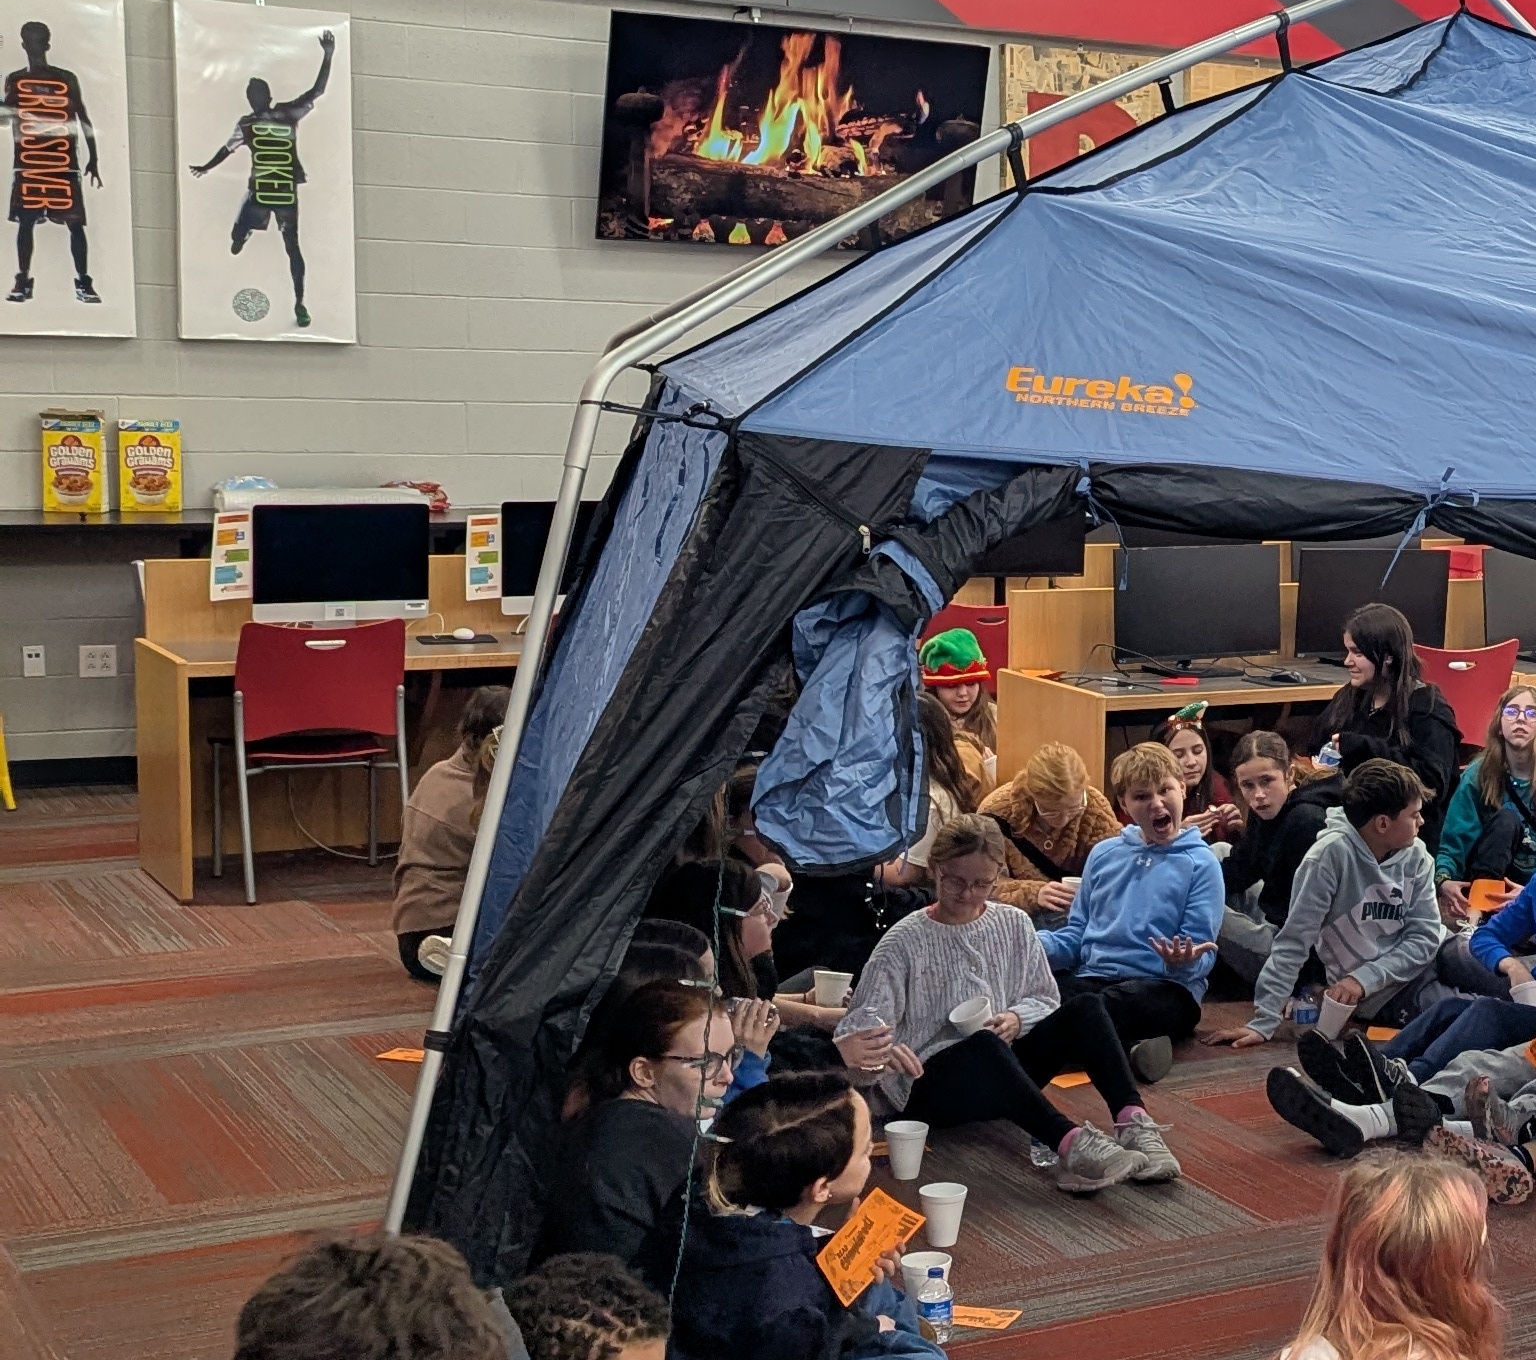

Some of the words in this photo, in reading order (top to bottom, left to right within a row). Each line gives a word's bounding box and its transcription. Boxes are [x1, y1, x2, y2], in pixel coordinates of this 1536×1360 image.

[17, 79, 73, 209] CROSSOVER
[252, 124, 295, 205] BOOKED
[1015, 393, 1115, 410] NORTHERN
[1120, 403, 1190, 417] BREEZE
